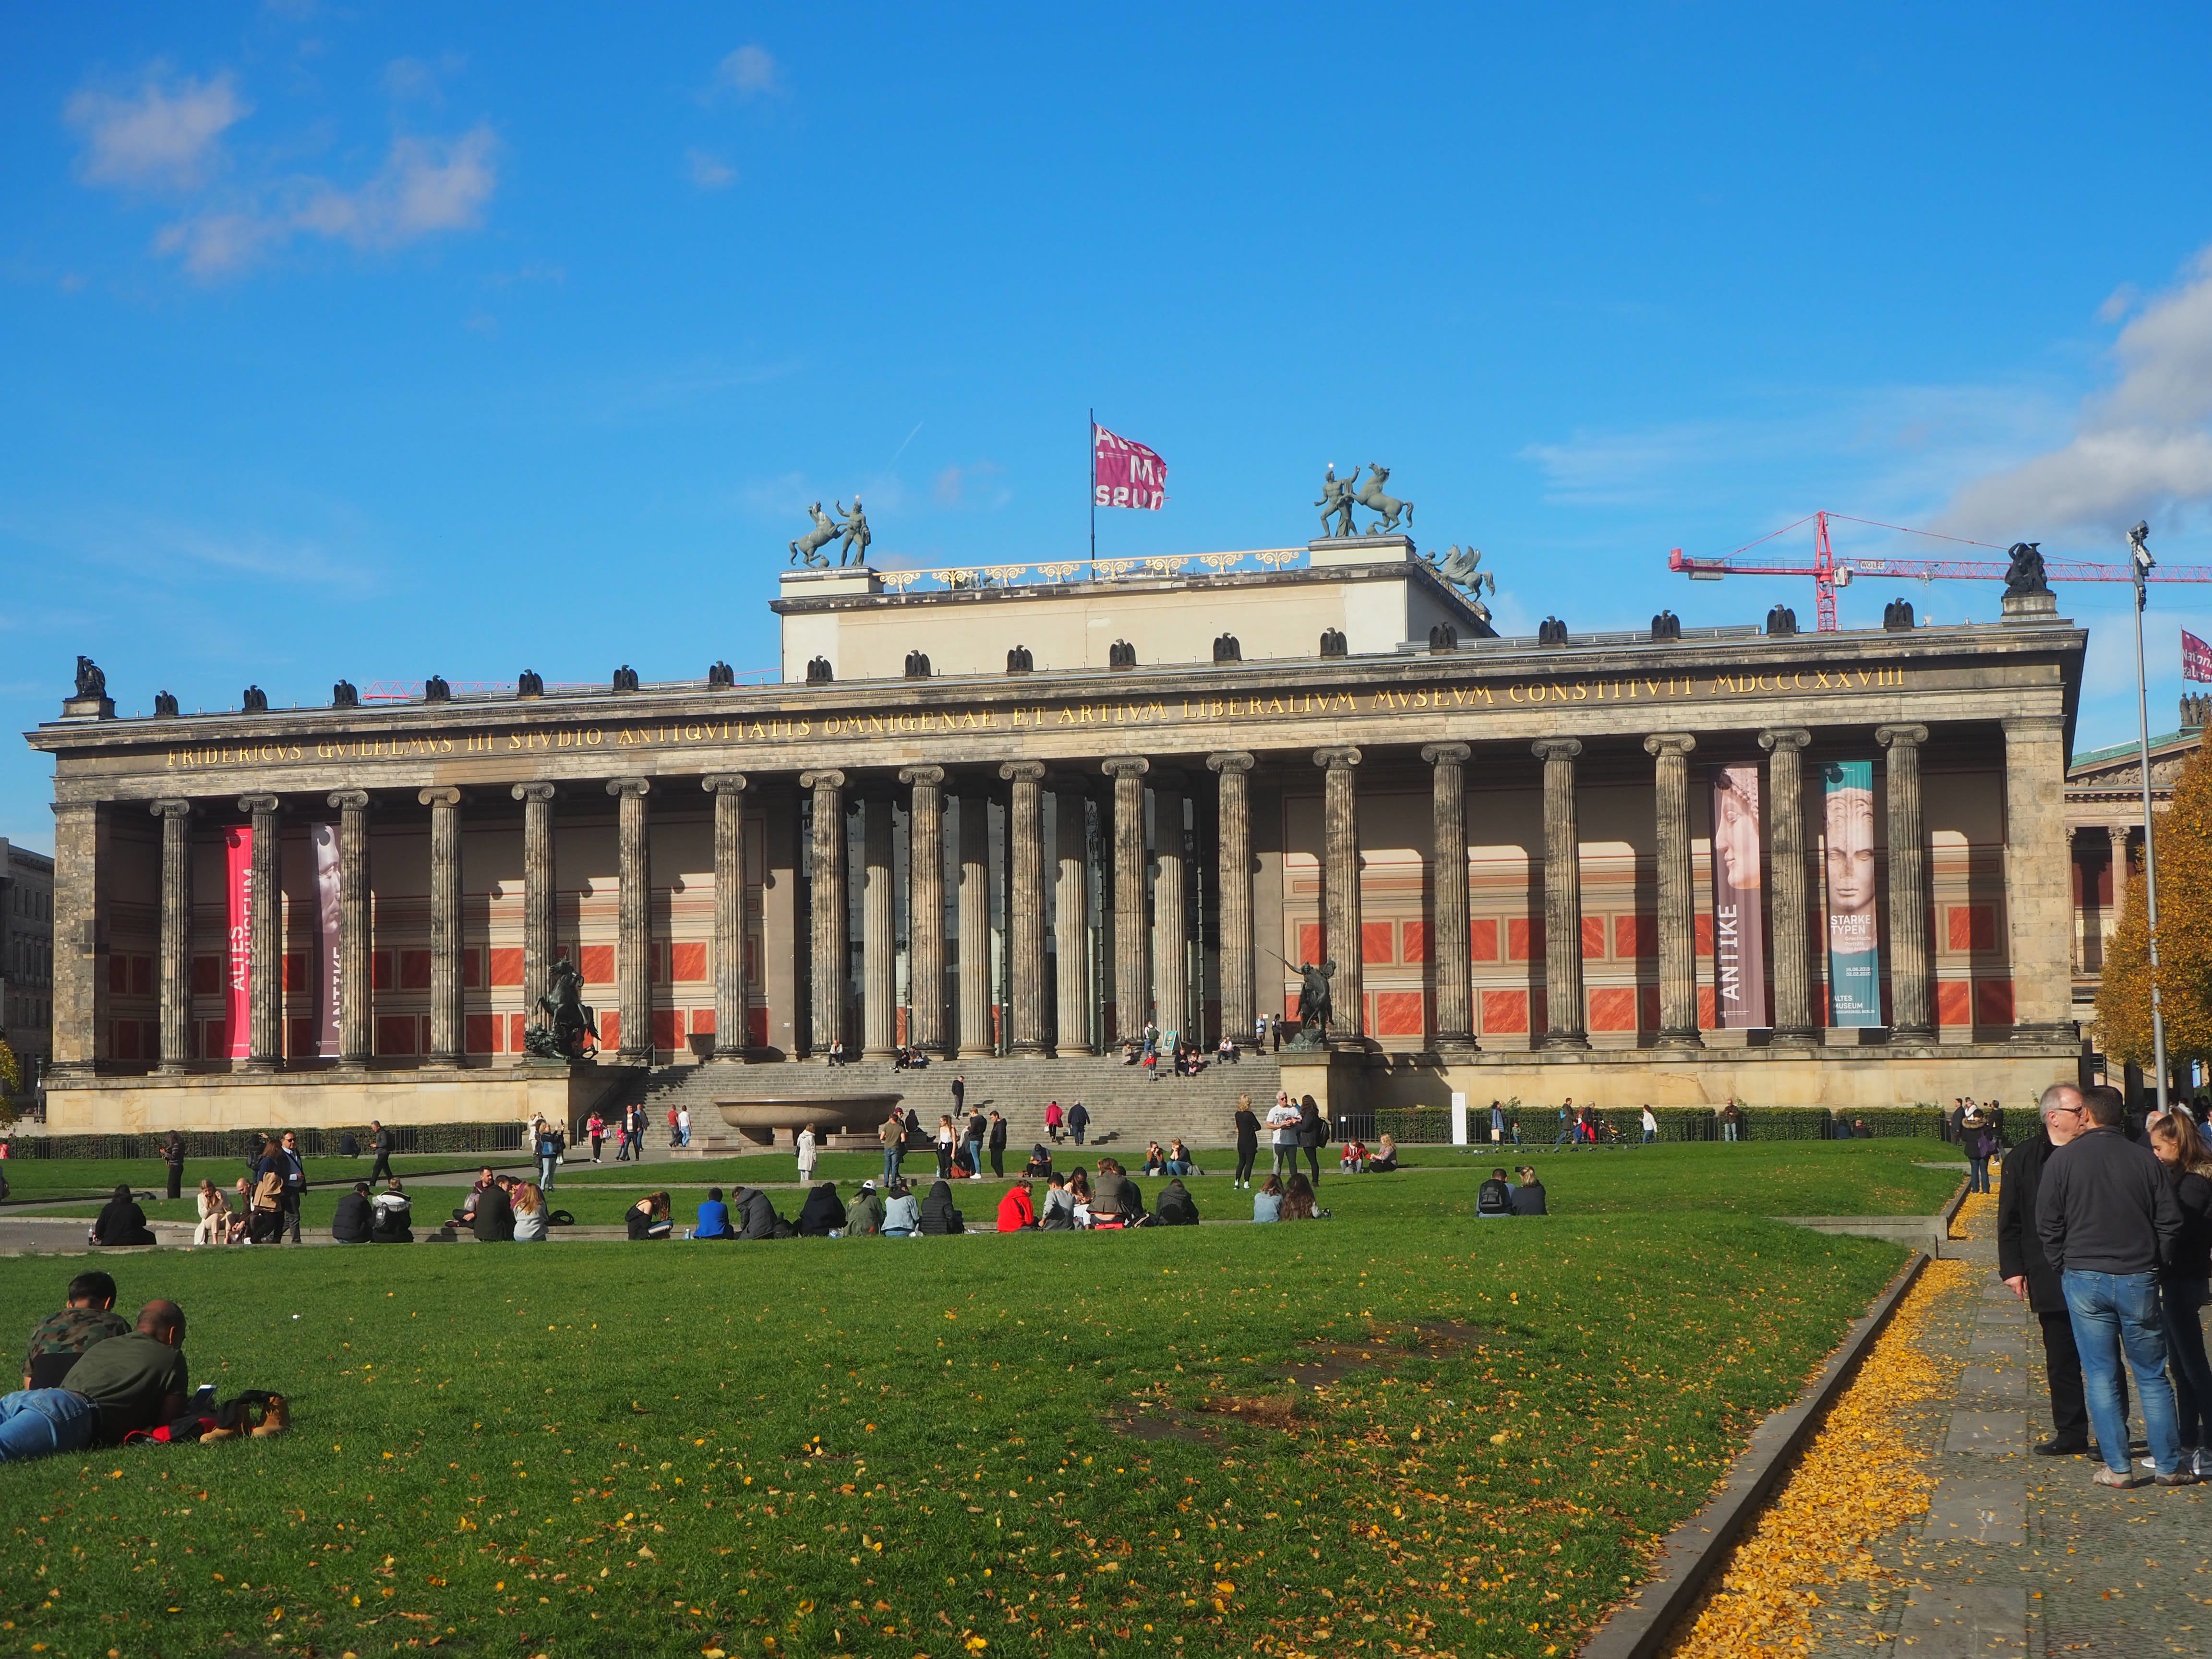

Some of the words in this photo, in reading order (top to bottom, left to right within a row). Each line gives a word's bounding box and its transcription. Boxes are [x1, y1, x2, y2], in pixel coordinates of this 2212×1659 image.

[168, 742, 302, 766] FRIDERICVS
[318, 734, 453, 758] GVILELMVS
[467, 733, 494, 751] III
[509, 728, 602, 749] STVDIO
[618, 718, 811, 744] ANTIQVITATIS
[825, 709, 998, 734] OMNIGENAE
[1013, 706, 1047, 726] ET
[1058, 700, 1168, 724] ARTIVM
[1183, 691, 1357, 719] LIBERALIVM
[1372, 685, 1494, 709] MVSEVM
[1509, 675, 1696, 702] CONSTITVIT
[1711, 665, 1904, 694] MDCCCXXVIII
[1718, 904, 1739, 1000] ANTIKE
[1831, 914, 1871, 925] STARKE
[1831, 925, 1865, 935] TYPEN
[229, 926, 245, 991] ALTES
